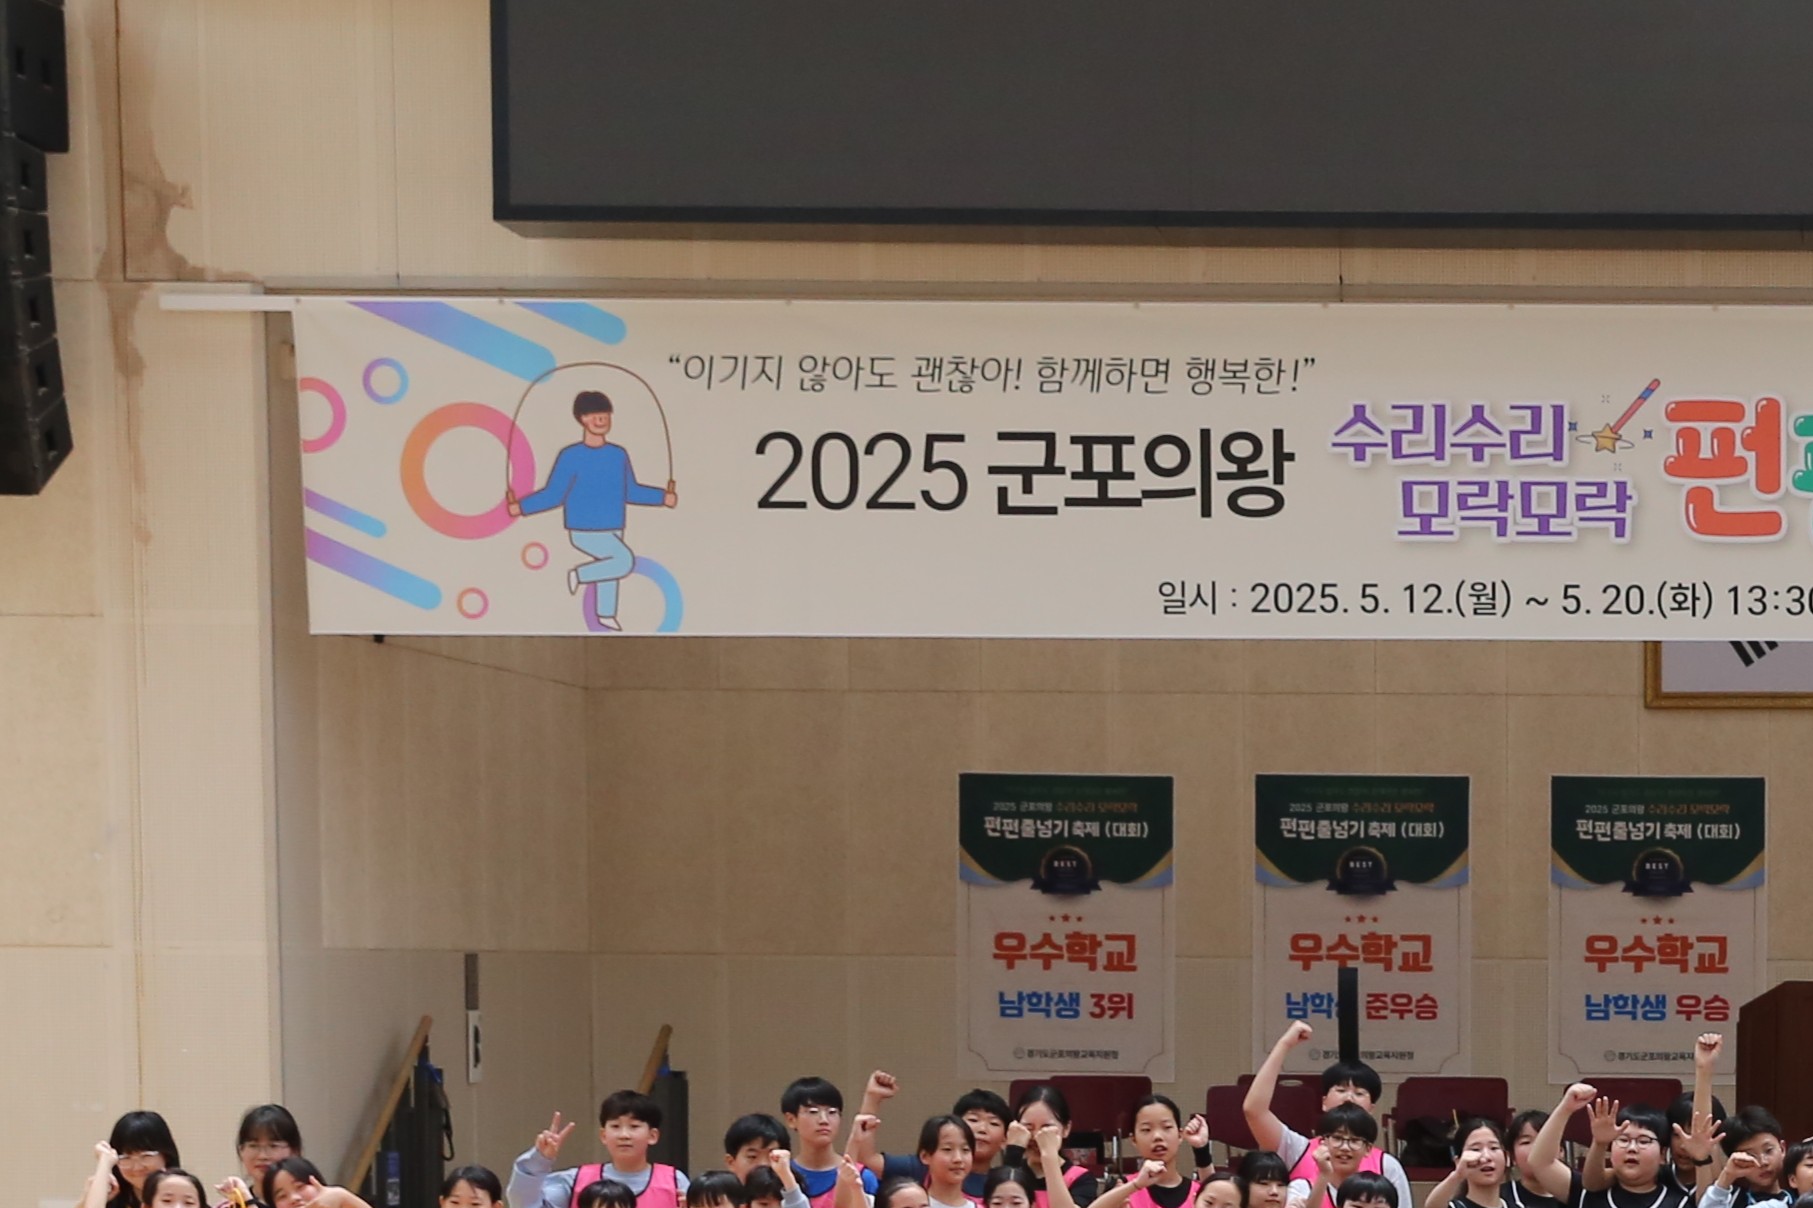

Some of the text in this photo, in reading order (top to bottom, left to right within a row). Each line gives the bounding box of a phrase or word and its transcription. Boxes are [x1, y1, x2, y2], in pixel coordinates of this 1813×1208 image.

[798, 355, 897, 393] 않아도
[911, 355, 1023, 394] 괜찮아!
[1037, 356, 1171, 395] 함께하면
[1328, 402, 1567, 463] 수리수리
[755, 427, 1297, 519] 2025 군포의왕
[1396, 478, 1634, 541] 모락모락
[1158, 580, 1217, 616] 일시
[1250, 582, 1349, 614] 2025.
[1359, 583, 1390, 615] 5.
[1403, 579, 1512, 619] 12.(월)
[1561, 583, 1591, 615] 5.
[1601, 580, 1713, 620] 20.(화)
[984, 816, 1149, 839] 편편줄넘기 축제 (대회)
[1280, 817, 1445, 840] 편편줄넘기 축제 (대회)
[1576, 819, 1741, 842] 편편줄넘기 축제 (대회)
[1053, 860, 1077, 868] BEST
[1350, 861, 1373, 869] BEST
[993, 931, 1138, 972] 우수학교
[1289, 932, 1434, 972] 우수학교
[1584, 933, 1729, 974] 우수학교
[998, 990, 1134, 1020] 남학생 3위
[1285, 992, 1439, 1020] 남학 준우승
[1585, 994, 1730, 1022] 남학생 우승
